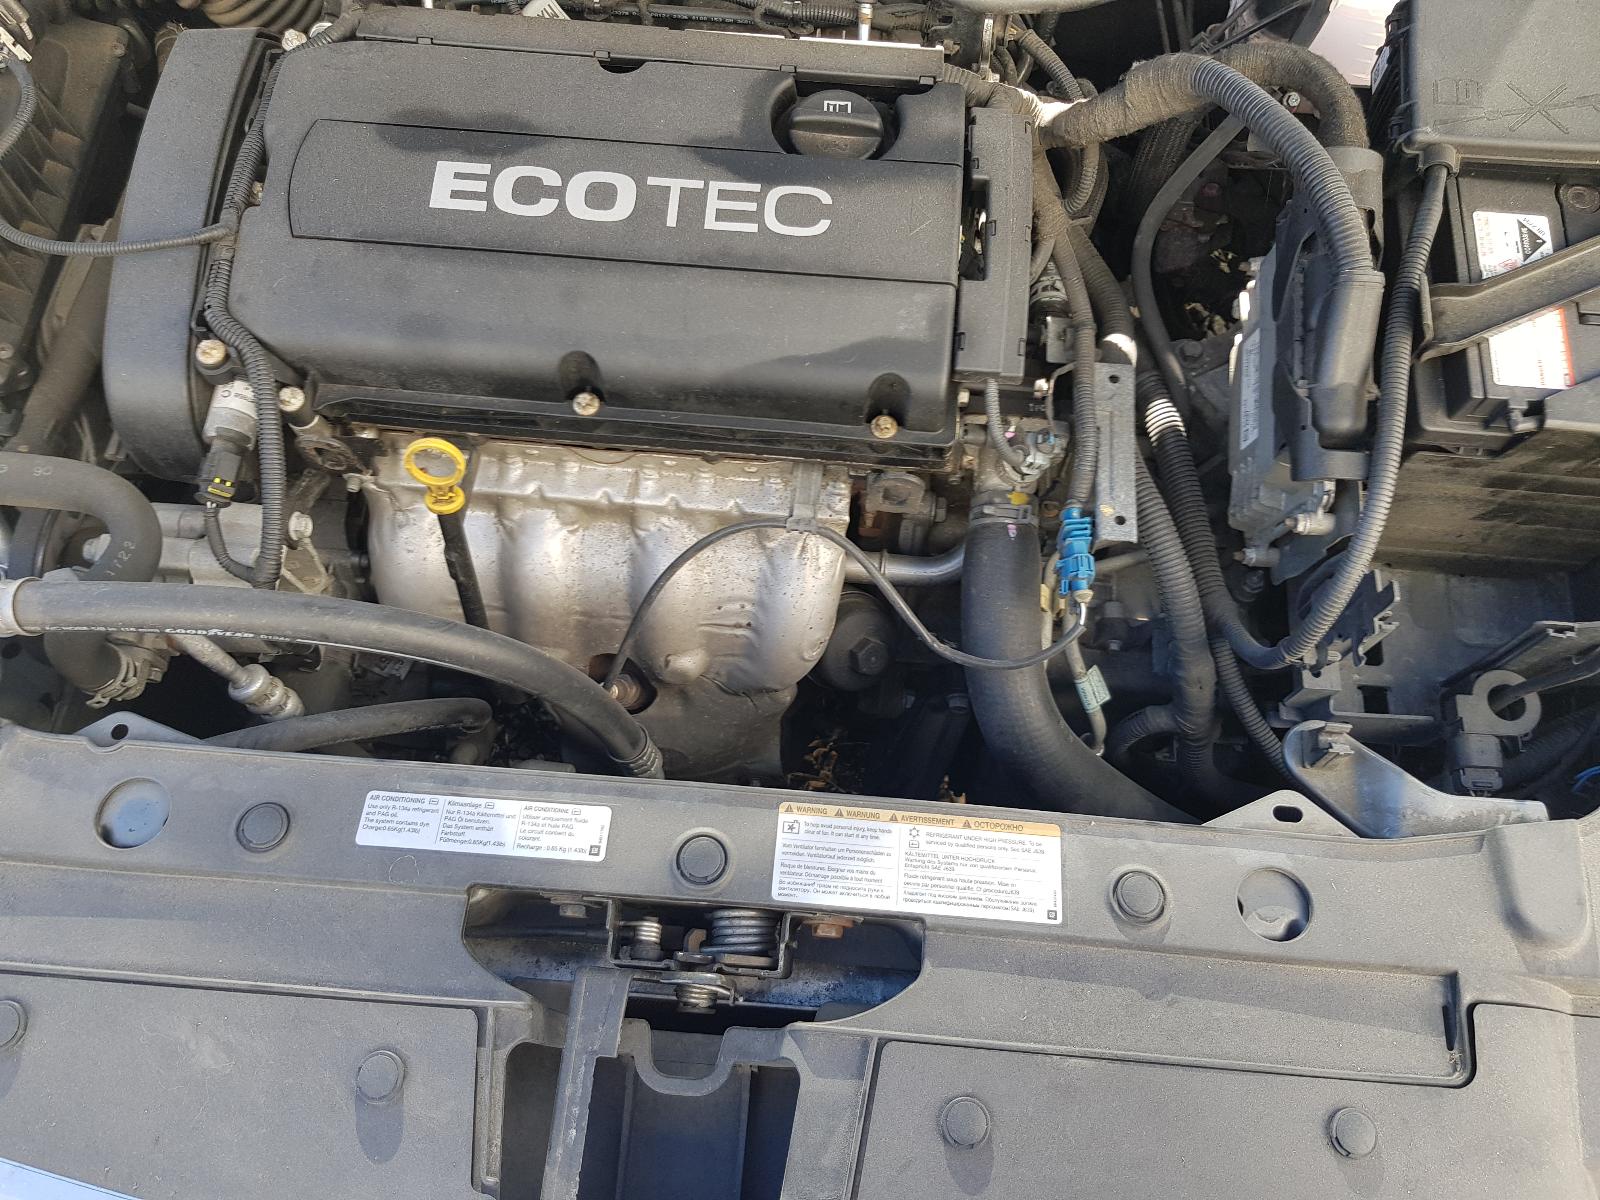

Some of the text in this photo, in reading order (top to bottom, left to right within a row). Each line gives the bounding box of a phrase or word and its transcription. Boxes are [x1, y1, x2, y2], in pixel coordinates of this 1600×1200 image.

[429, 160, 832, 237] ECOTEC
[381, 795, 426, 803] CONDITIONING
[447, 799, 482, 809] Klimaanlage
[795, 805, 955, 826] WARNING WARNUNG AVERTISSEMENT
[453, 823, 474, 831] System
[974, 820, 1023, 832] ОСТОРОЖНО
[963, 834, 982, 842] UNDER
